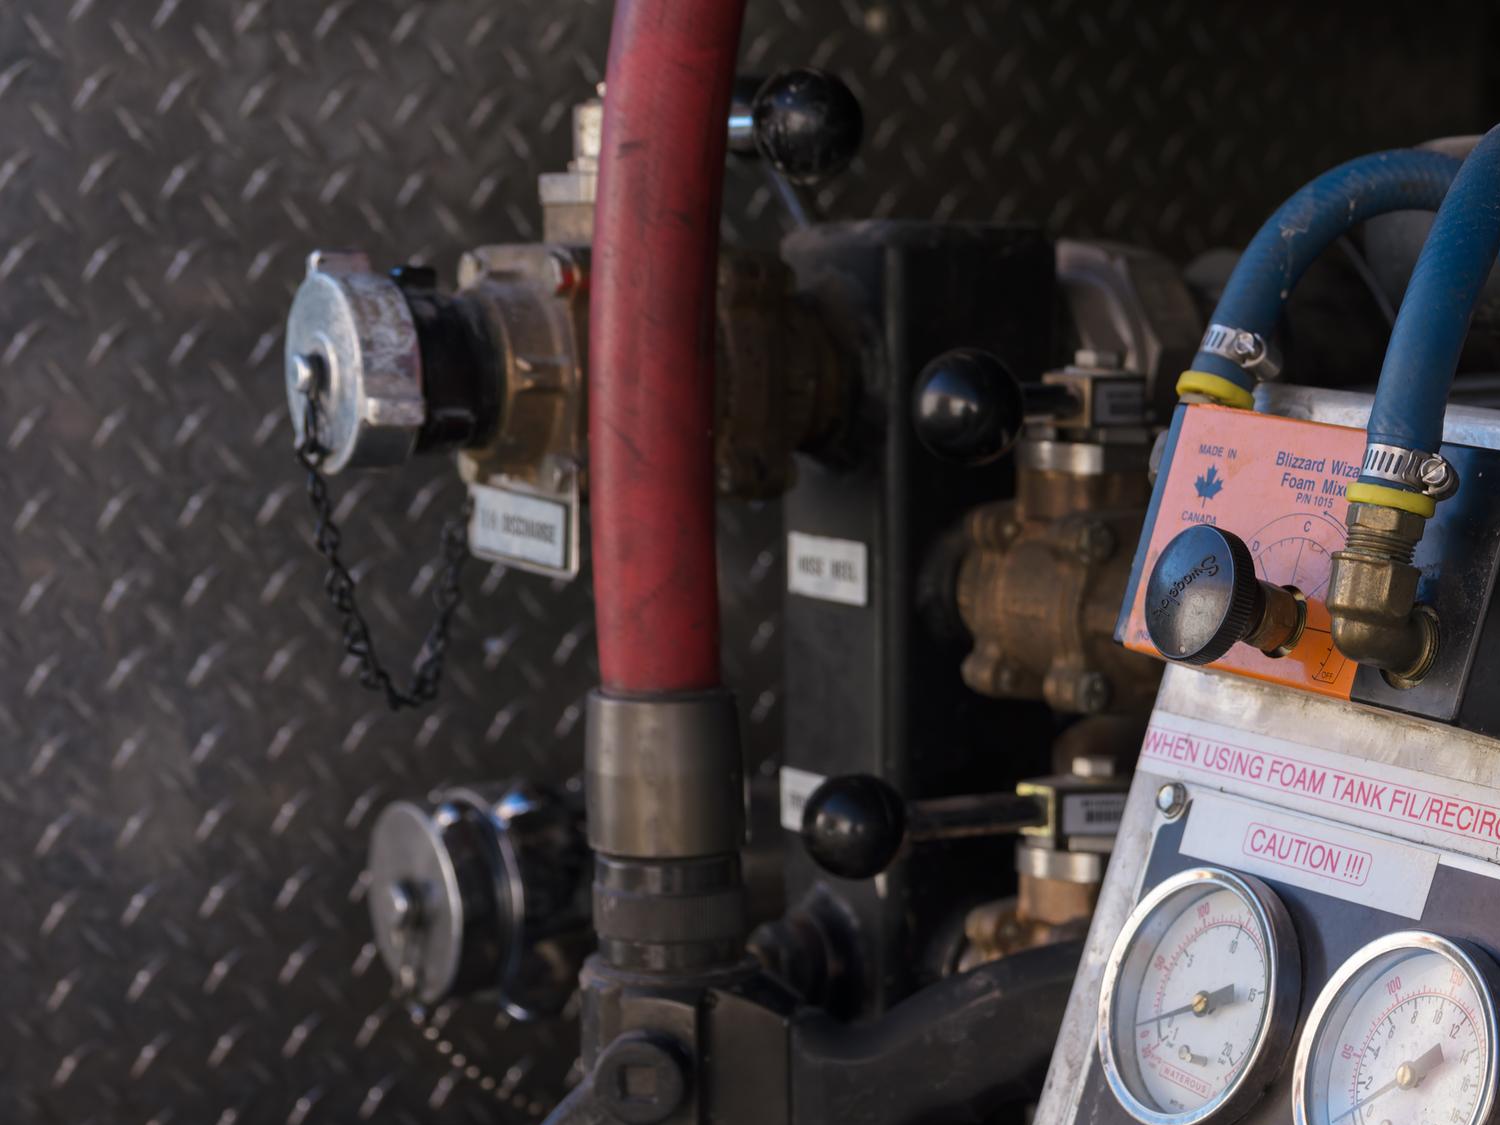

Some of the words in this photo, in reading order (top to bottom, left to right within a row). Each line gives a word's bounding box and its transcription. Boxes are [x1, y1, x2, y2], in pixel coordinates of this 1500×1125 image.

[1198, 444, 1223, 458] MADE
[1228, 448, 1237, 459] IN
[1276, 451, 1326, 473] Blizzard
[1331, 460, 1361, 479] Wiza
[1281, 472, 1315, 491] Foam
[1322, 479, 1348, 497] Mix
[1296, 492, 1311, 504] P/N
[1314, 496, 1333, 508] 1015
[1181, 511, 1217, 525] CANADA
[1303, 521, 1312, 532] C
[1252, 540, 1260, 552] D
[1145, 730, 1200, 763] WHEN
[1203, 746, 1263, 779] USING
[1267, 760, 1327, 795] FOAM
[1332, 774, 1387, 810] TANK
[1251, 829, 1342, 874] CAUTION
[1343, 854, 1364, 880] !!!
[1386, 976, 1402, 995] 100
[1411, 1011, 1418, 1024] 8
[1449, 1023, 1461, 1040] 12
[1341, 1043, 1354, 1060] 50
[1163, 1067, 1207, 1094] WATEROUS
[1365, 1076, 1374, 1090] 2
